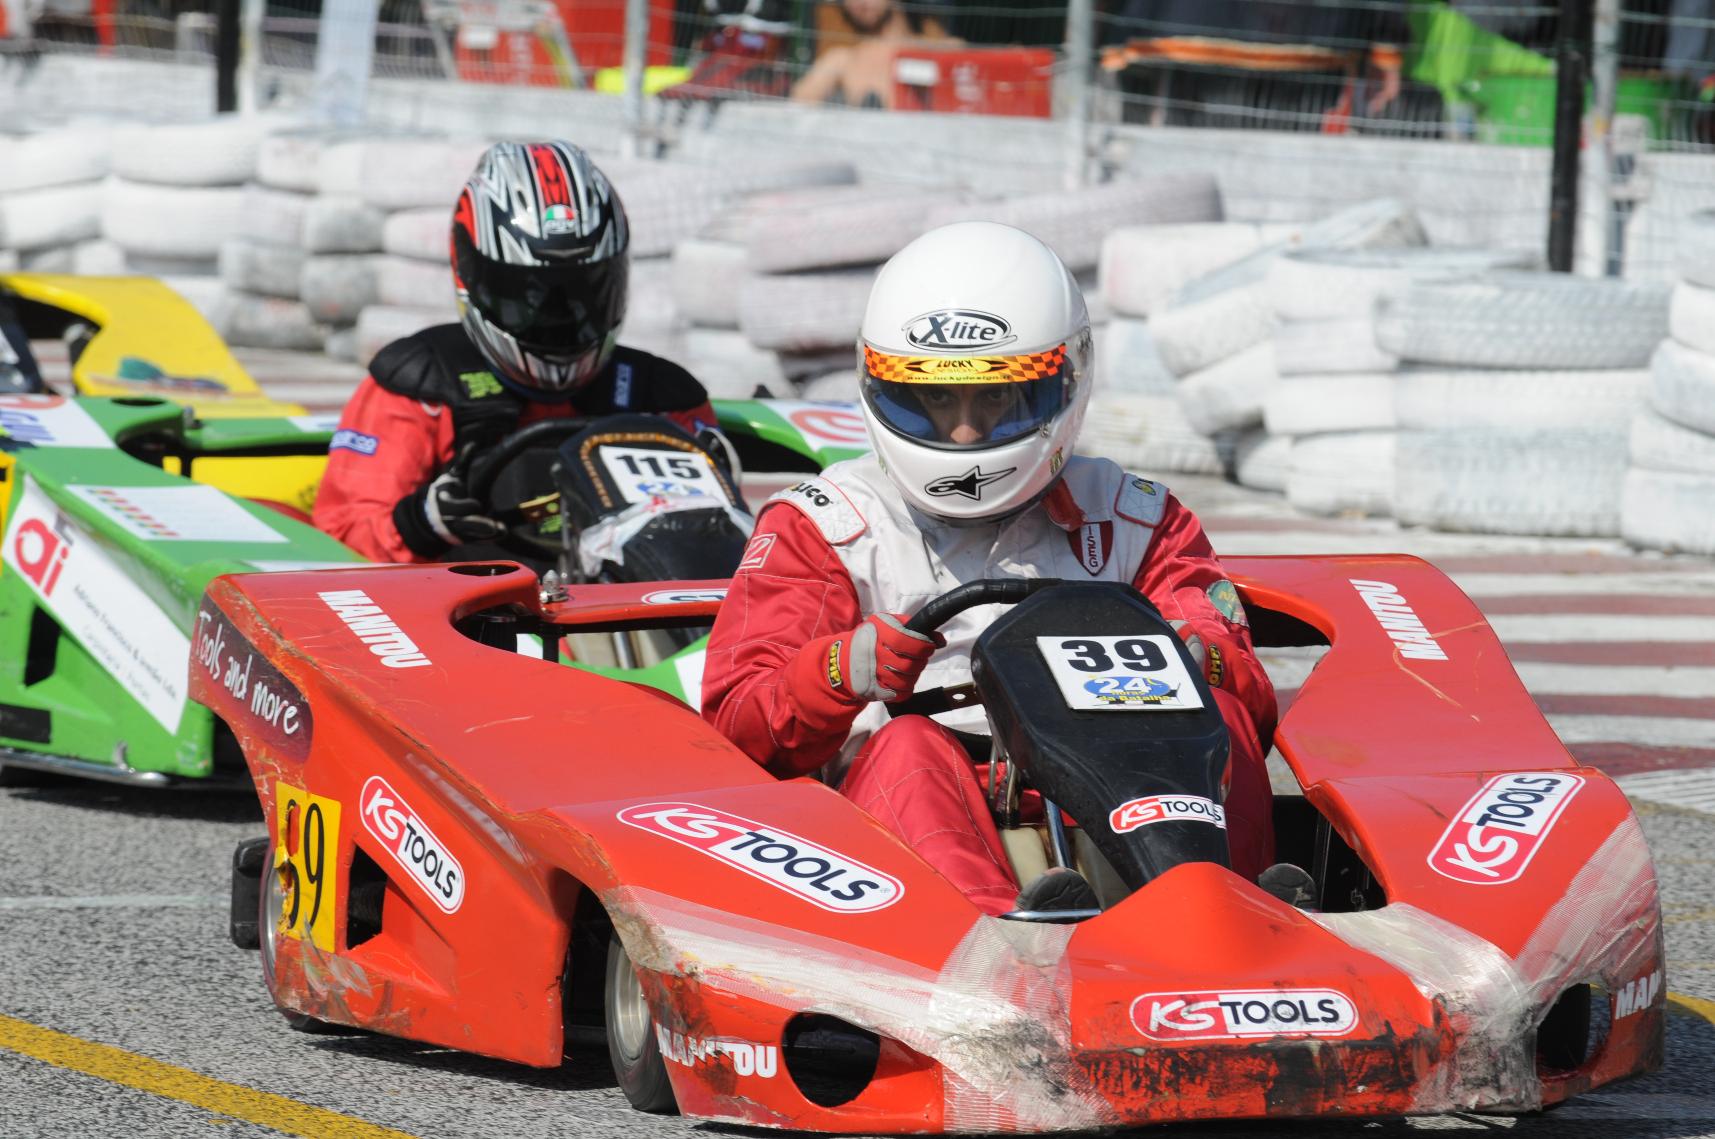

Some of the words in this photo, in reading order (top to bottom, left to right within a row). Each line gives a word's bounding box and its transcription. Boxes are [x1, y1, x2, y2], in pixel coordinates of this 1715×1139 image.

[917, 316, 997, 344] X-lite
[936, 359, 975, 368] LUCKY
[615, 455, 702, 480] 115
[317, 589, 432, 668] MANITOU
[1348, 579, 1449, 660] MANITOU
[1061, 639, 1168, 672] 39
[195, 610, 225, 680] Tools
[224, 653, 253, 700] and
[251, 680, 299, 735] more
[1094, 677, 1152, 695] 24
[1160, 801, 1222, 821] TOOLS
[1476, 777, 1562, 827] TOOLS
[403, 822, 456, 898] TOOLS
[731, 831, 880, 900] TOOLS
[1219, 999, 1340, 1025] TOOLS
